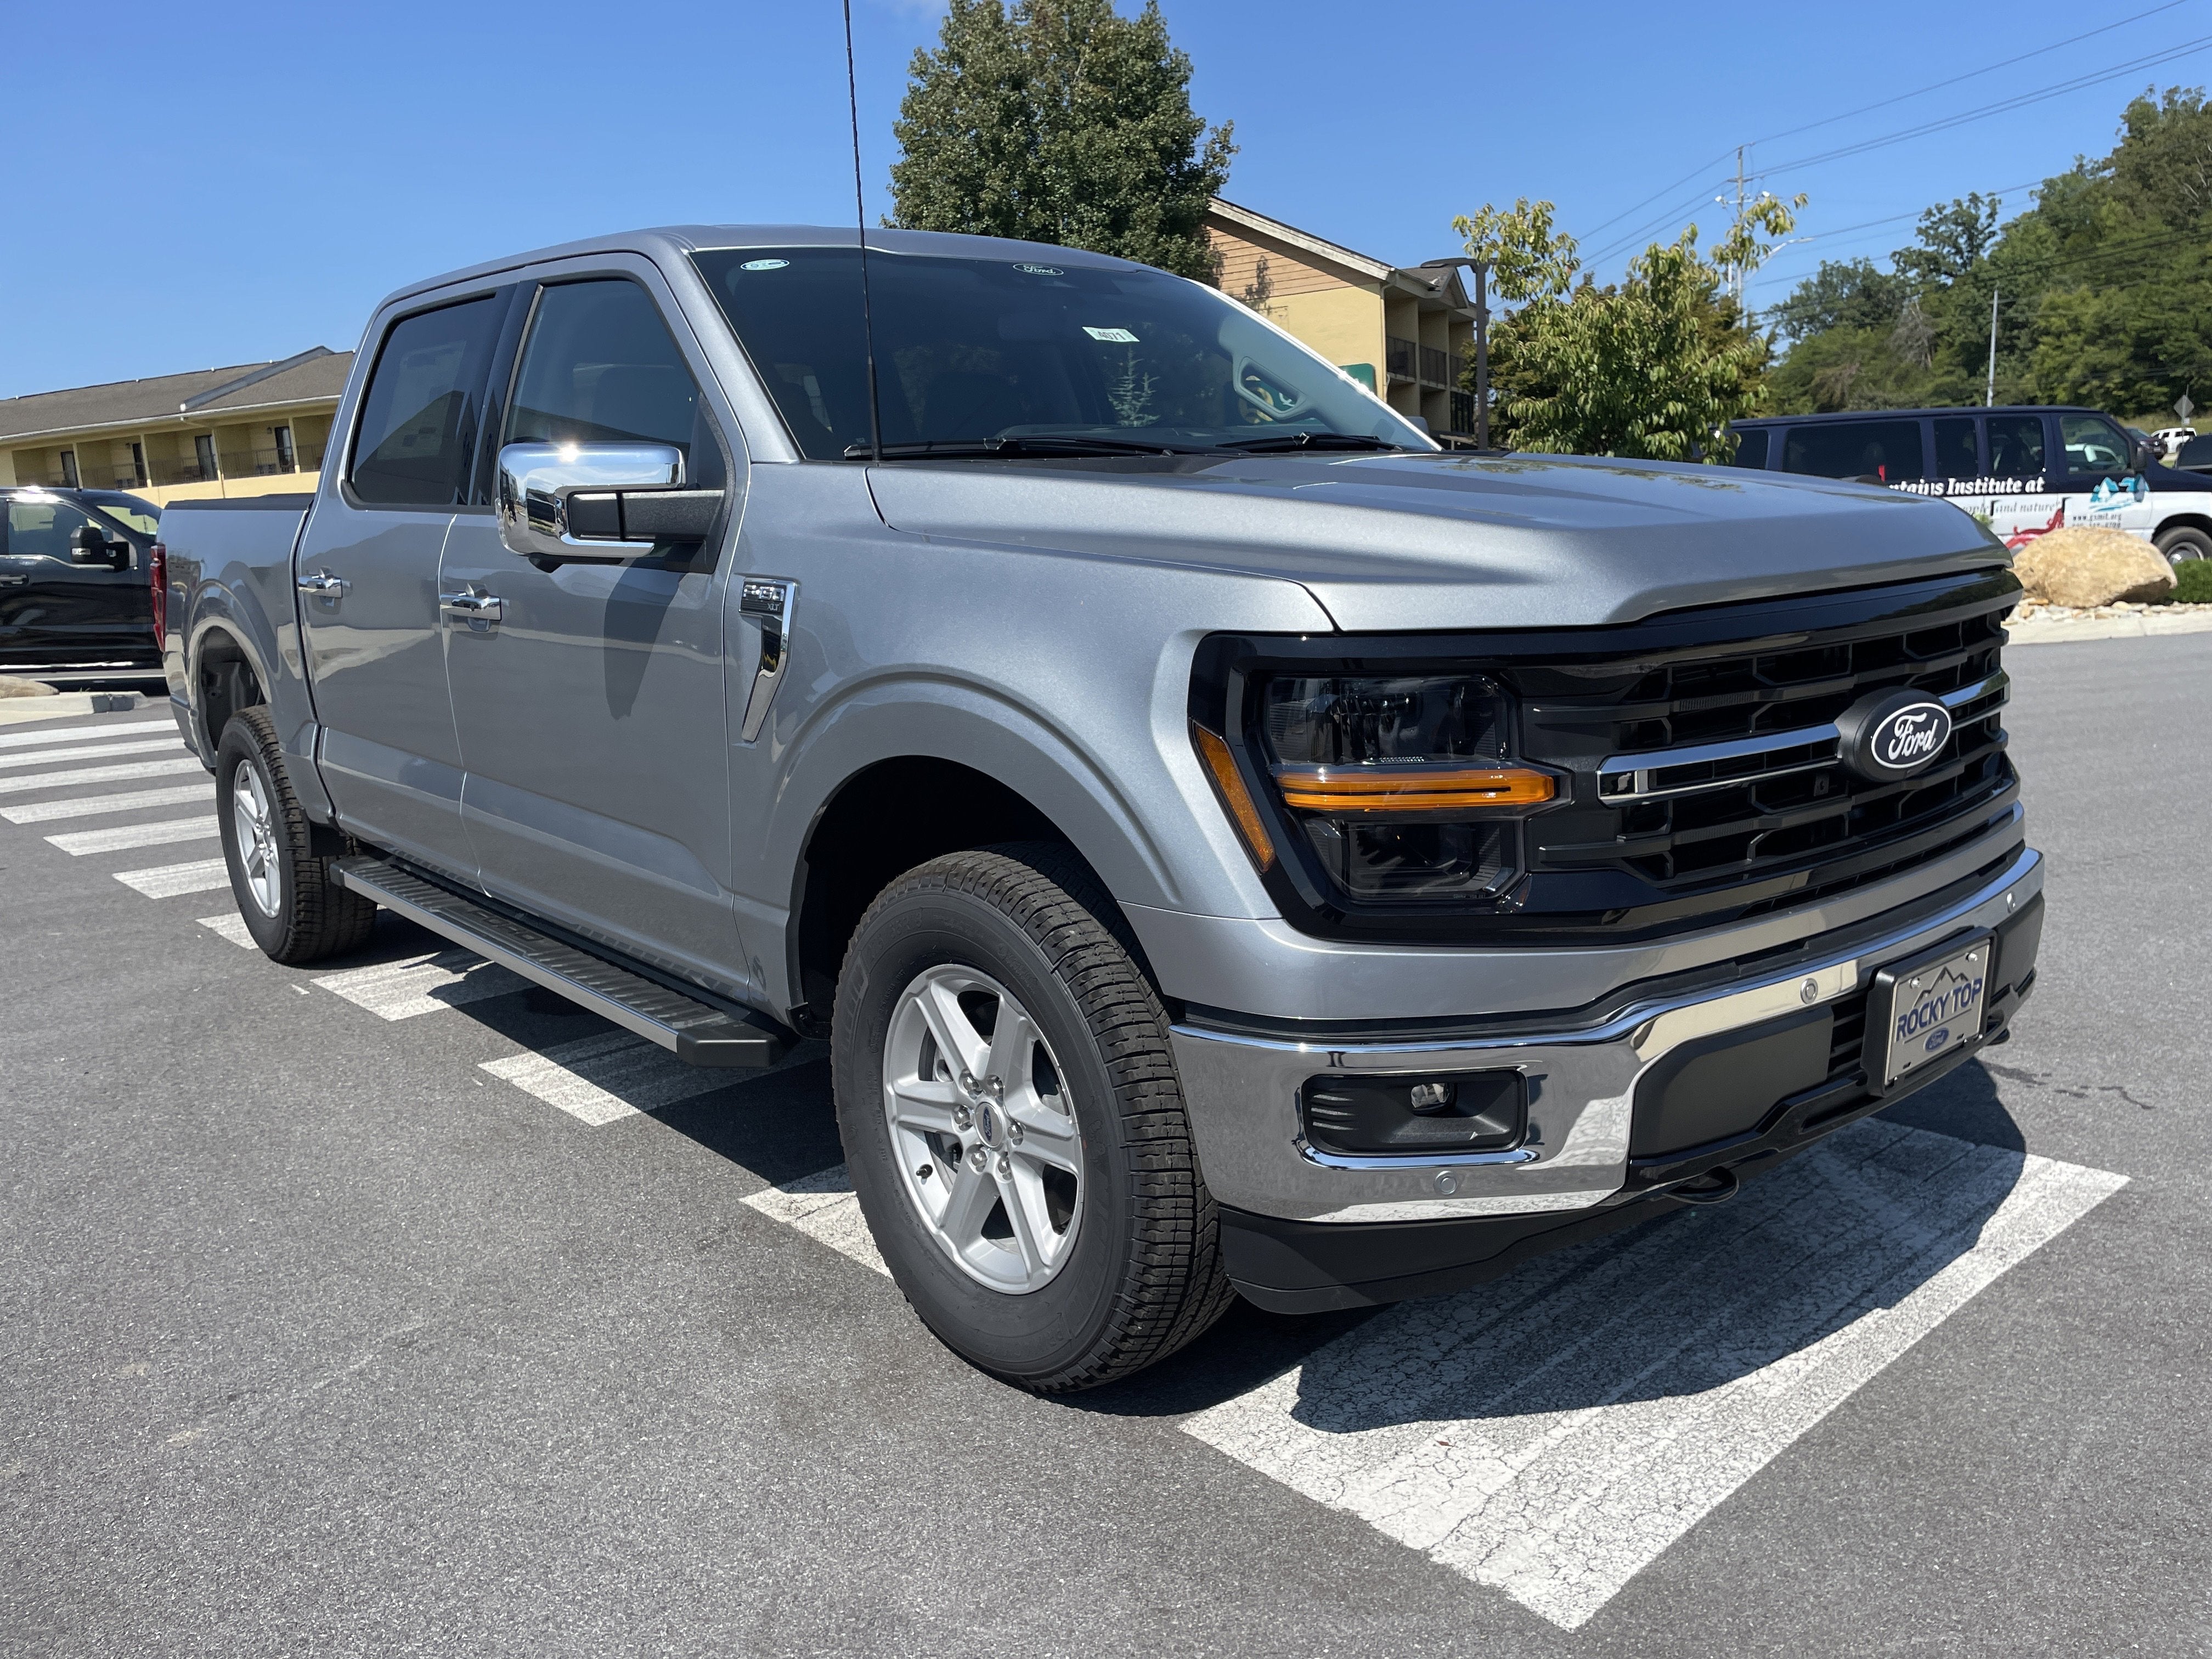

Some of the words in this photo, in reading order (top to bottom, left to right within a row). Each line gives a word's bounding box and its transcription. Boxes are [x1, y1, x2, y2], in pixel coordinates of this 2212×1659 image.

[1023, 264, 1056, 274] Ford
[1946, 476, 2022, 495] Institute
[2025, 476, 2045, 493] at
[768, 602, 782, 611] XLT
[1888, 712, 1939, 760] Ford
[1895, 992, 1950, 1041] ROCKY
[1952, 977, 1983, 1014] TOP
